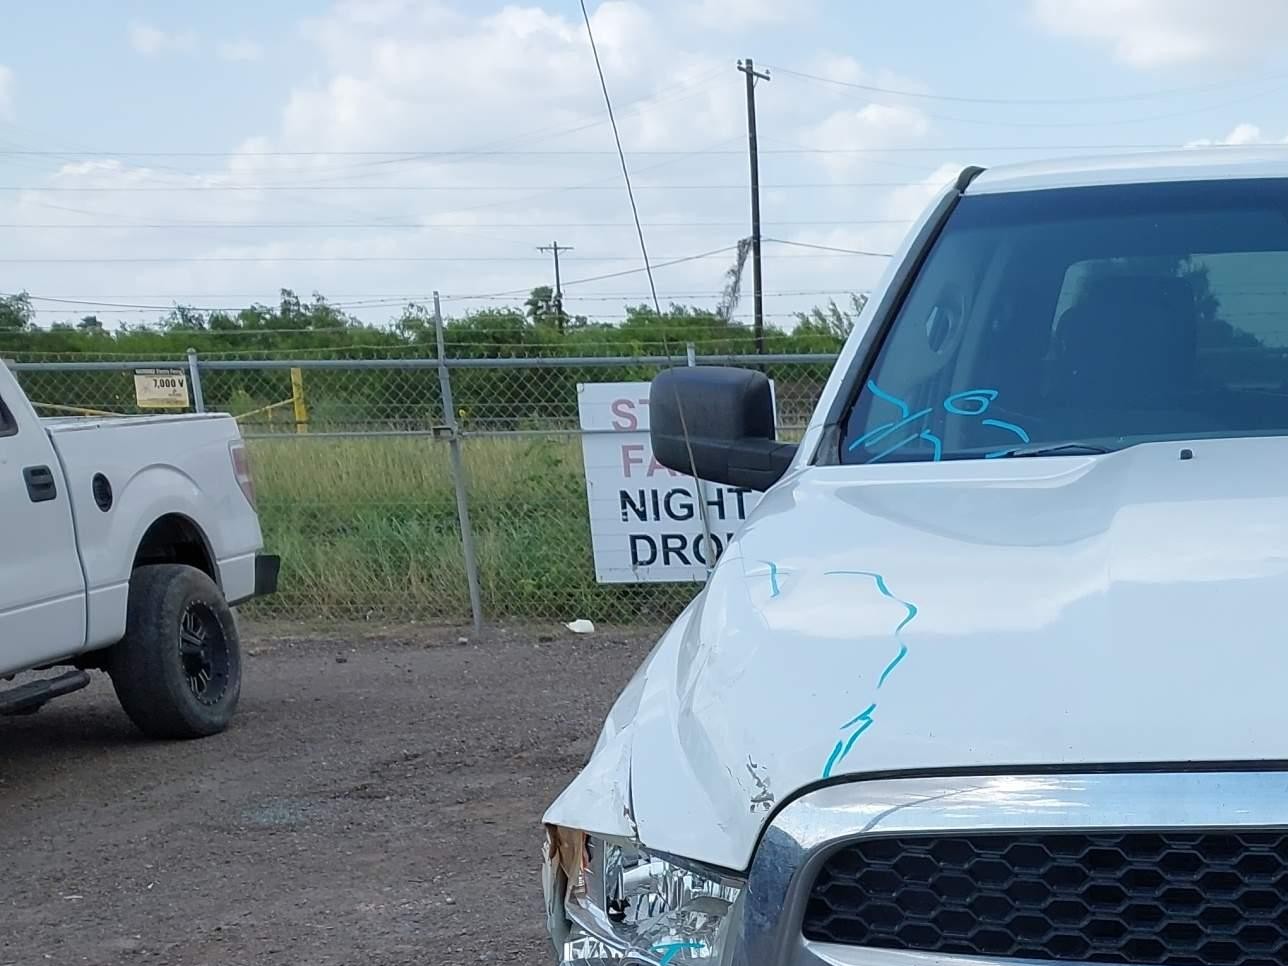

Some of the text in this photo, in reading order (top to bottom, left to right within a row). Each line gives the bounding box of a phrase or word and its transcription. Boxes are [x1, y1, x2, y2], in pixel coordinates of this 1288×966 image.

[153, 379, 184, 389] 7,000 V
[618, 487, 752, 522] NIGHT
[628, 531, 735, 567] DRO
